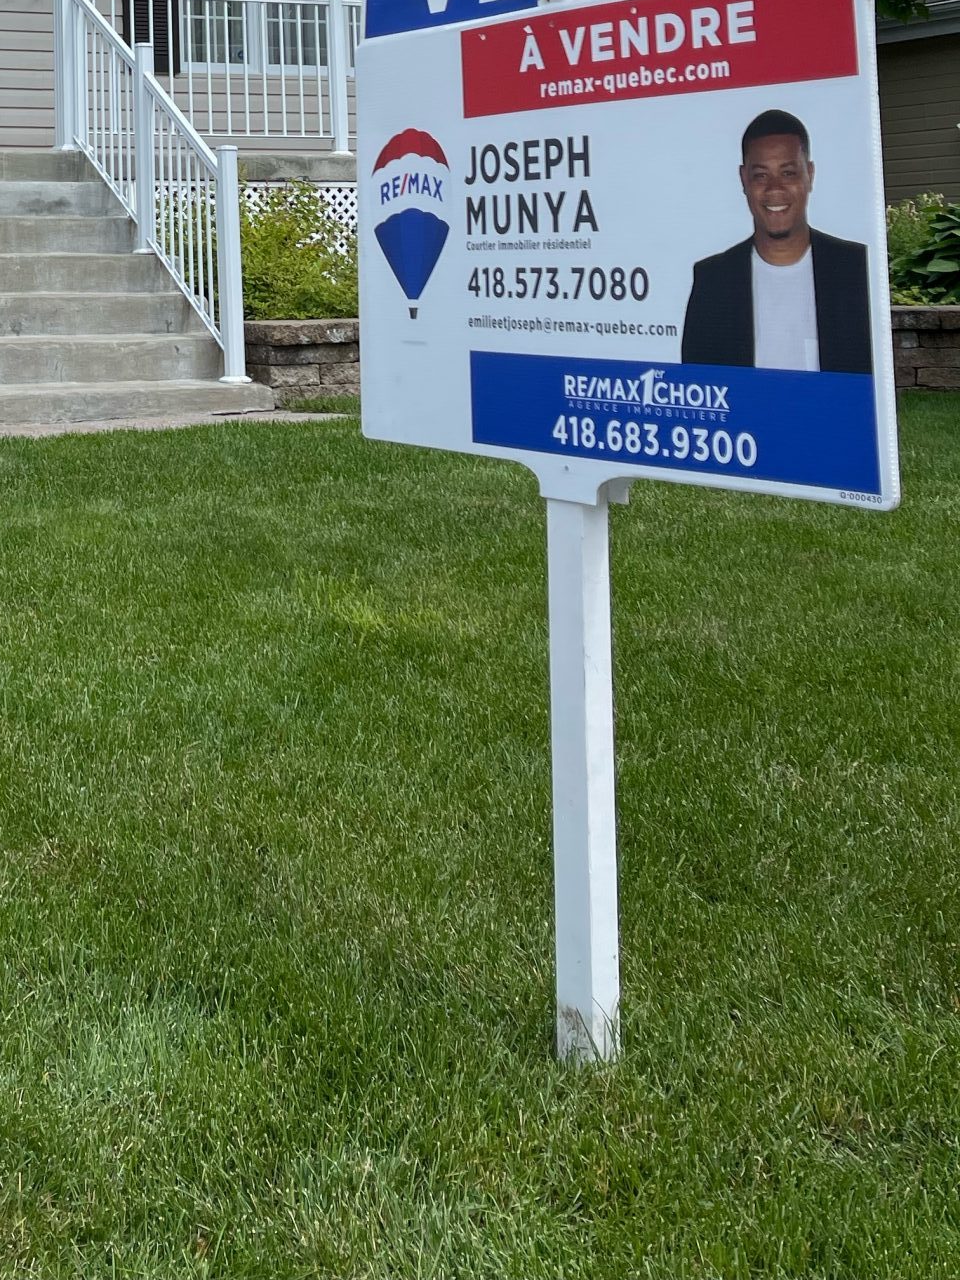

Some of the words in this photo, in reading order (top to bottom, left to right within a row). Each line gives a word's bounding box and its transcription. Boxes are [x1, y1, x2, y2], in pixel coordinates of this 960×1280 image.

[519, 25, 545, 73] À
[559, 0, 757, 66] VENDRE
[540, 59, 730, 99] remax-quebec.com
[464, 135, 591, 186] JOSEPH
[380, 173, 444, 206] RE/MAX
[466, 189, 600, 235] MUNYA
[466, 240, 496, 251] Courtier
[497, 239, 540, 251] immobilier
[542, 238, 592, 250] résidentiel
[468, 266, 650, 302] 418.573.7080
[468, 315, 678, 337] emilieetjoseph@remax-quebec.com
[564, 374, 640, 401] RE/MAX
[654, 382, 730, 409] CHOIX
[568, 400, 619, 413] AGENCE
[552, 414, 758, 467] 418.683.9300
